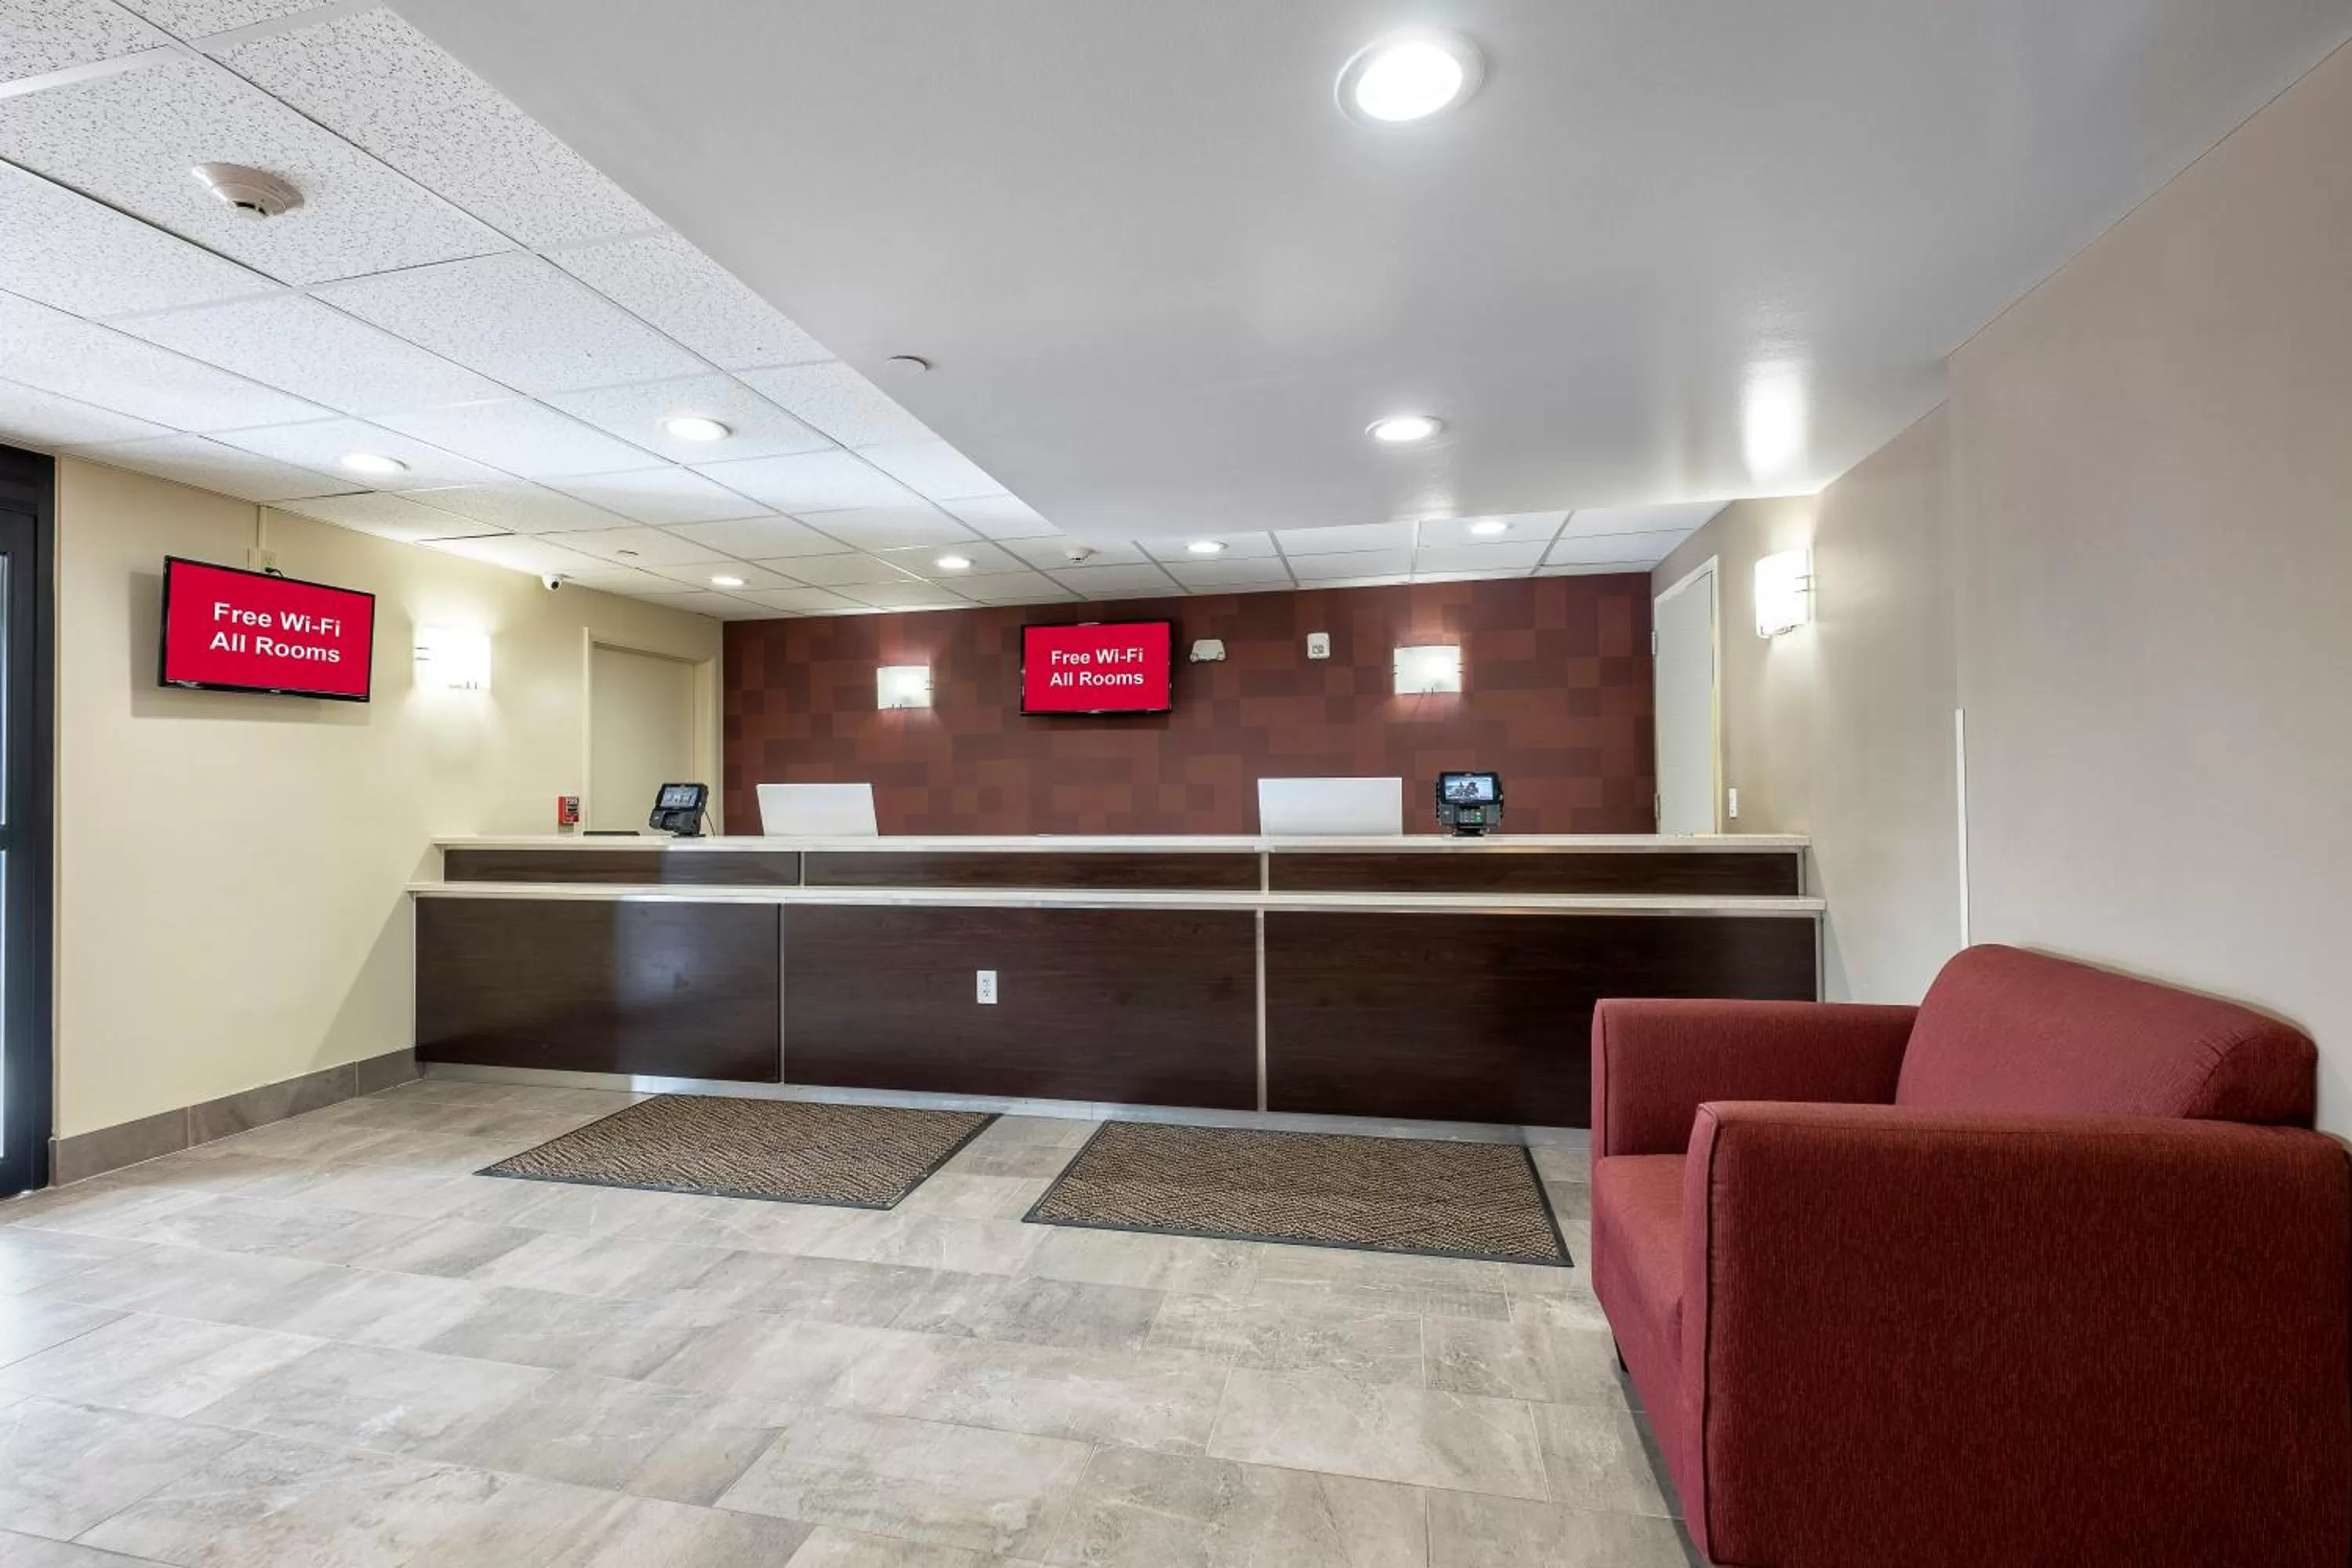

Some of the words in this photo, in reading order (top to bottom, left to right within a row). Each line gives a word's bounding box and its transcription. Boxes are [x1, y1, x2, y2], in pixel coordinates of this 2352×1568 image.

[213, 601, 272, 628] Free
[280, 611, 341, 637] Wi-Fi
[209, 631, 246, 653] All
[256, 636, 340, 662] Rooms
[1051, 649, 1091, 665] Free
[1096, 648, 1144, 664] Wi-Fi
[1050, 672, 1073, 686] All
[1080, 671, 1144, 686] Rooms
